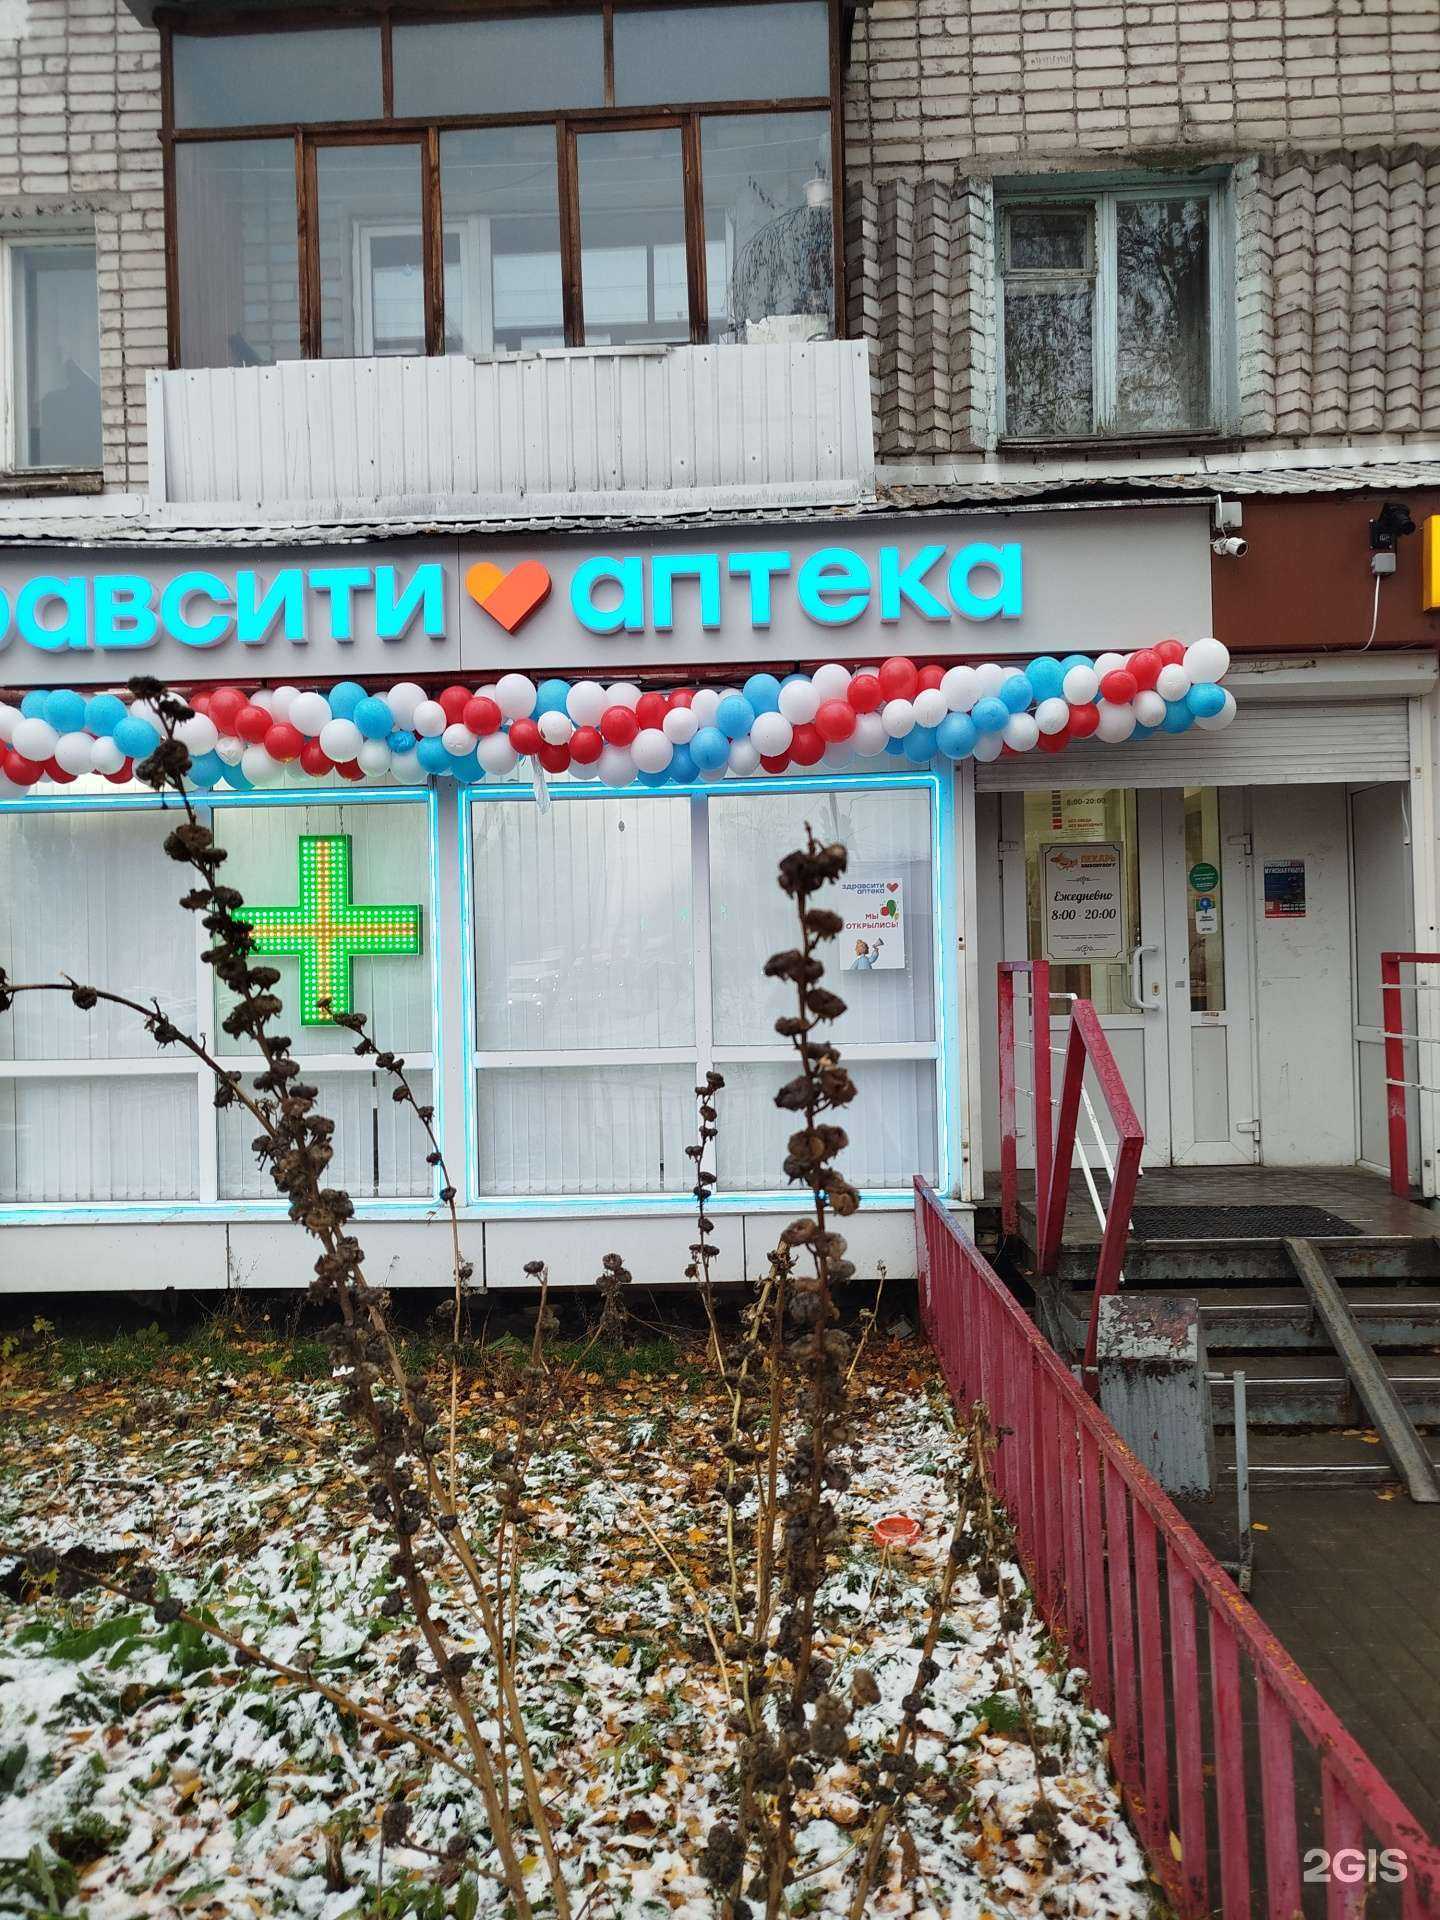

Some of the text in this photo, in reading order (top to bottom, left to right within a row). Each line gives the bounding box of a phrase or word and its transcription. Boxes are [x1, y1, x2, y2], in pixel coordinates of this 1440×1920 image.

[0, 542, 1023, 652] авсити аптека
[1054, 889, 1114, 904] Ежедневно
[1051, 909, 1076, 920] 8:00
[1085, 908, 1117, 920] 20:00
